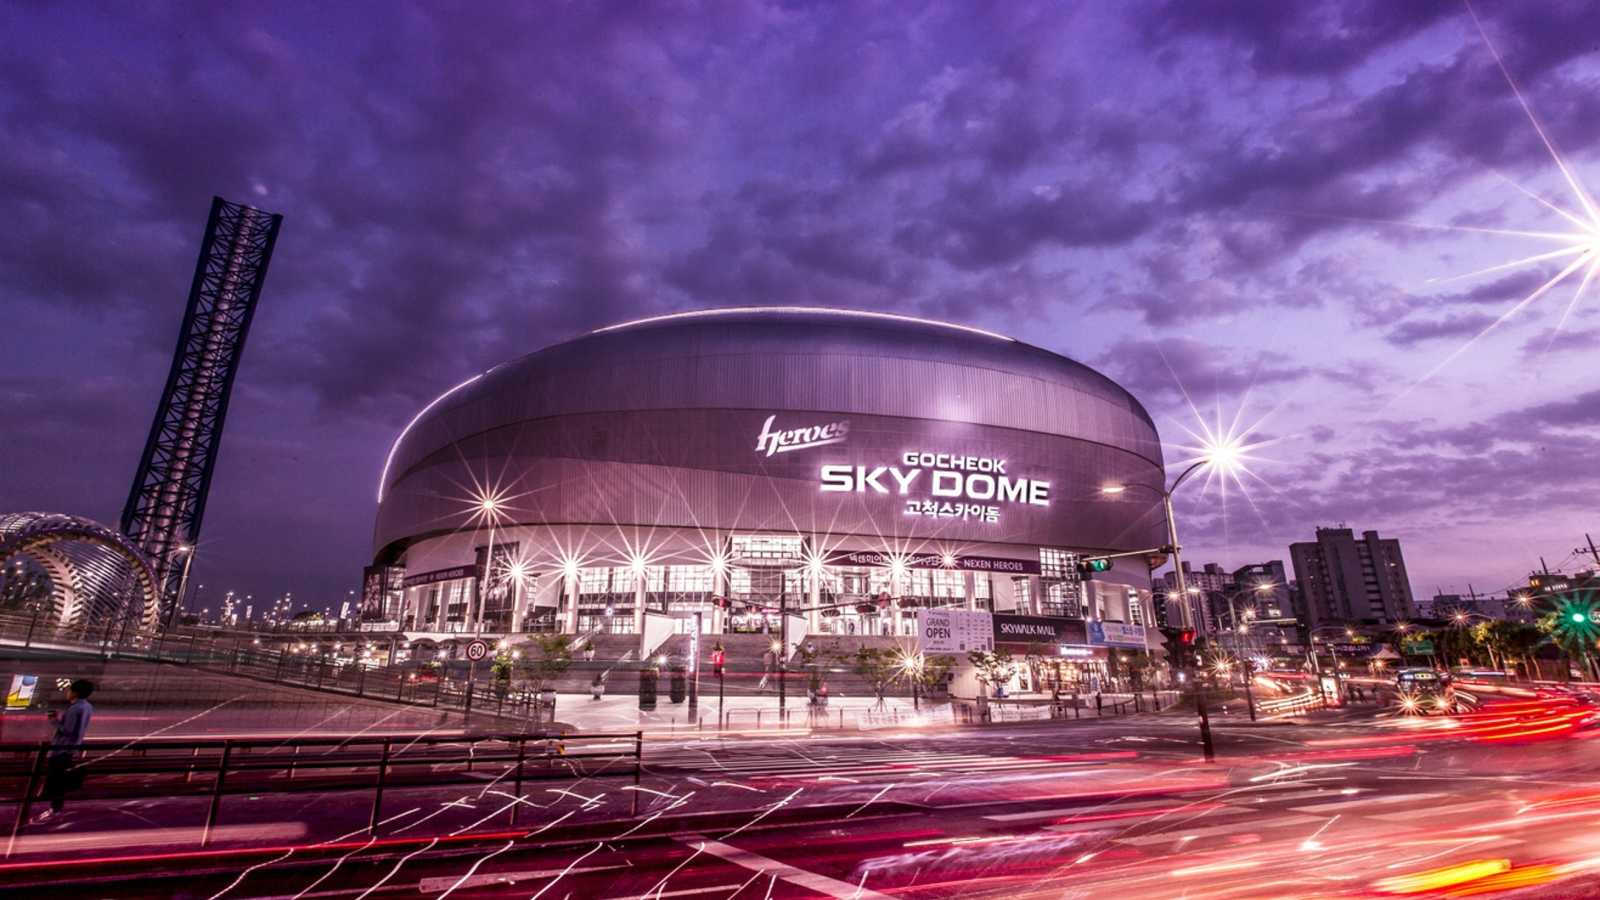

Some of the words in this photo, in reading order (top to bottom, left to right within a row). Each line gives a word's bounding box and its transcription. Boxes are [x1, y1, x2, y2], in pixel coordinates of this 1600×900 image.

[755, 415, 850, 457] heroes
[903, 452, 1006, 472] GOCHEOK
[820, 465, 922, 495] SKY
[932, 470, 1050, 506] DOME
[905, 499, 1001, 522] 고척스카이돔
[963, 559, 991, 568] NEXEN
[993, 560, 1023, 570] HEROES
[927, 617, 950, 627] GRAND
[926, 628, 951, 638] OPEN
[1000, 623, 1036, 634] SKYWALK
[1037, 625, 1056, 636] MALL
[471, 645, 483, 656] 60
